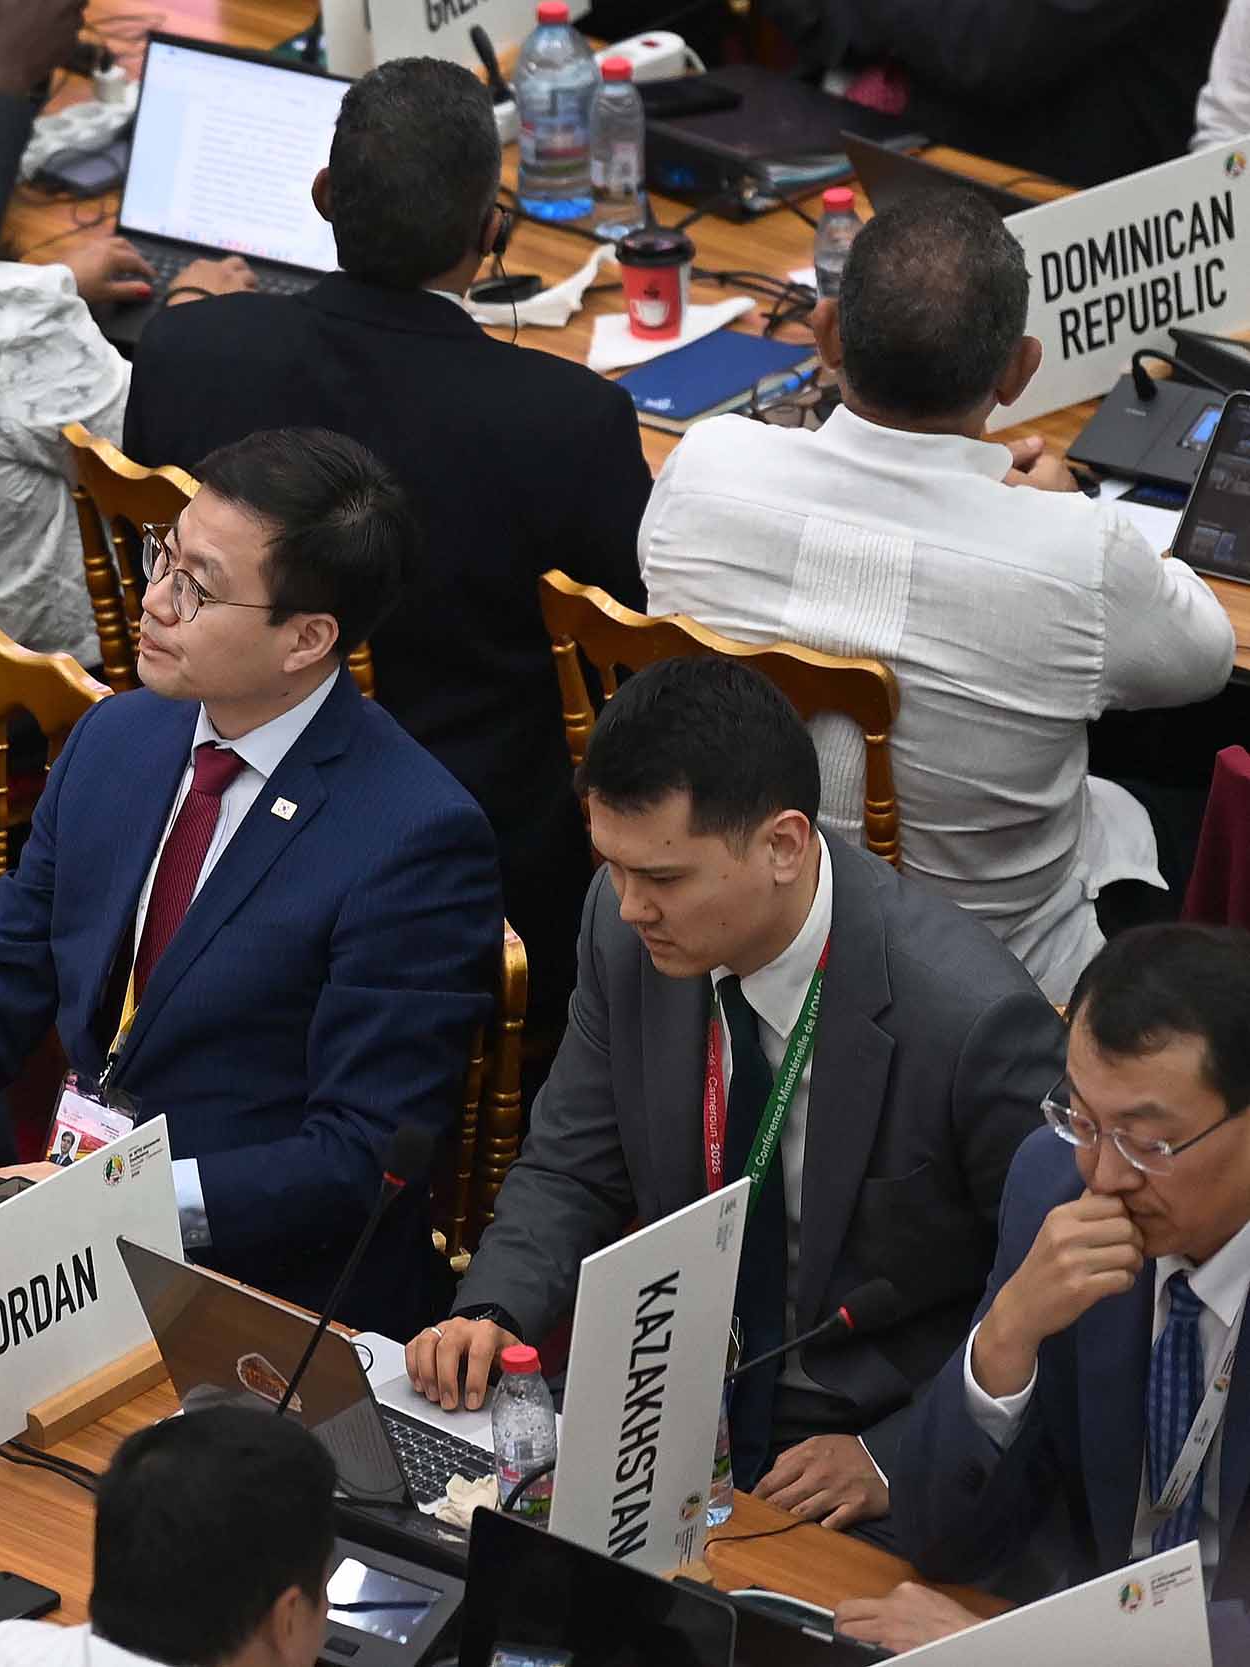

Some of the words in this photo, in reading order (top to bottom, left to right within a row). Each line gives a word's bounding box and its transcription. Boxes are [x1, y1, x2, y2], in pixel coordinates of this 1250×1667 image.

[1041, 190, 1235, 303] DOMINICAN
[1059, 258, 1228, 360] REPUBLIC
[707, 1077, 719, 1138] Cameroun
[755, 1104, 784, 1167] Conférence
[778, 1034, 810, 1104] Ministérielle
[803, 1019, 816, 1033] de
[710, 1143, 721, 1175] 2026
[606, 1269, 680, 1560] KAZAKHSTAN
